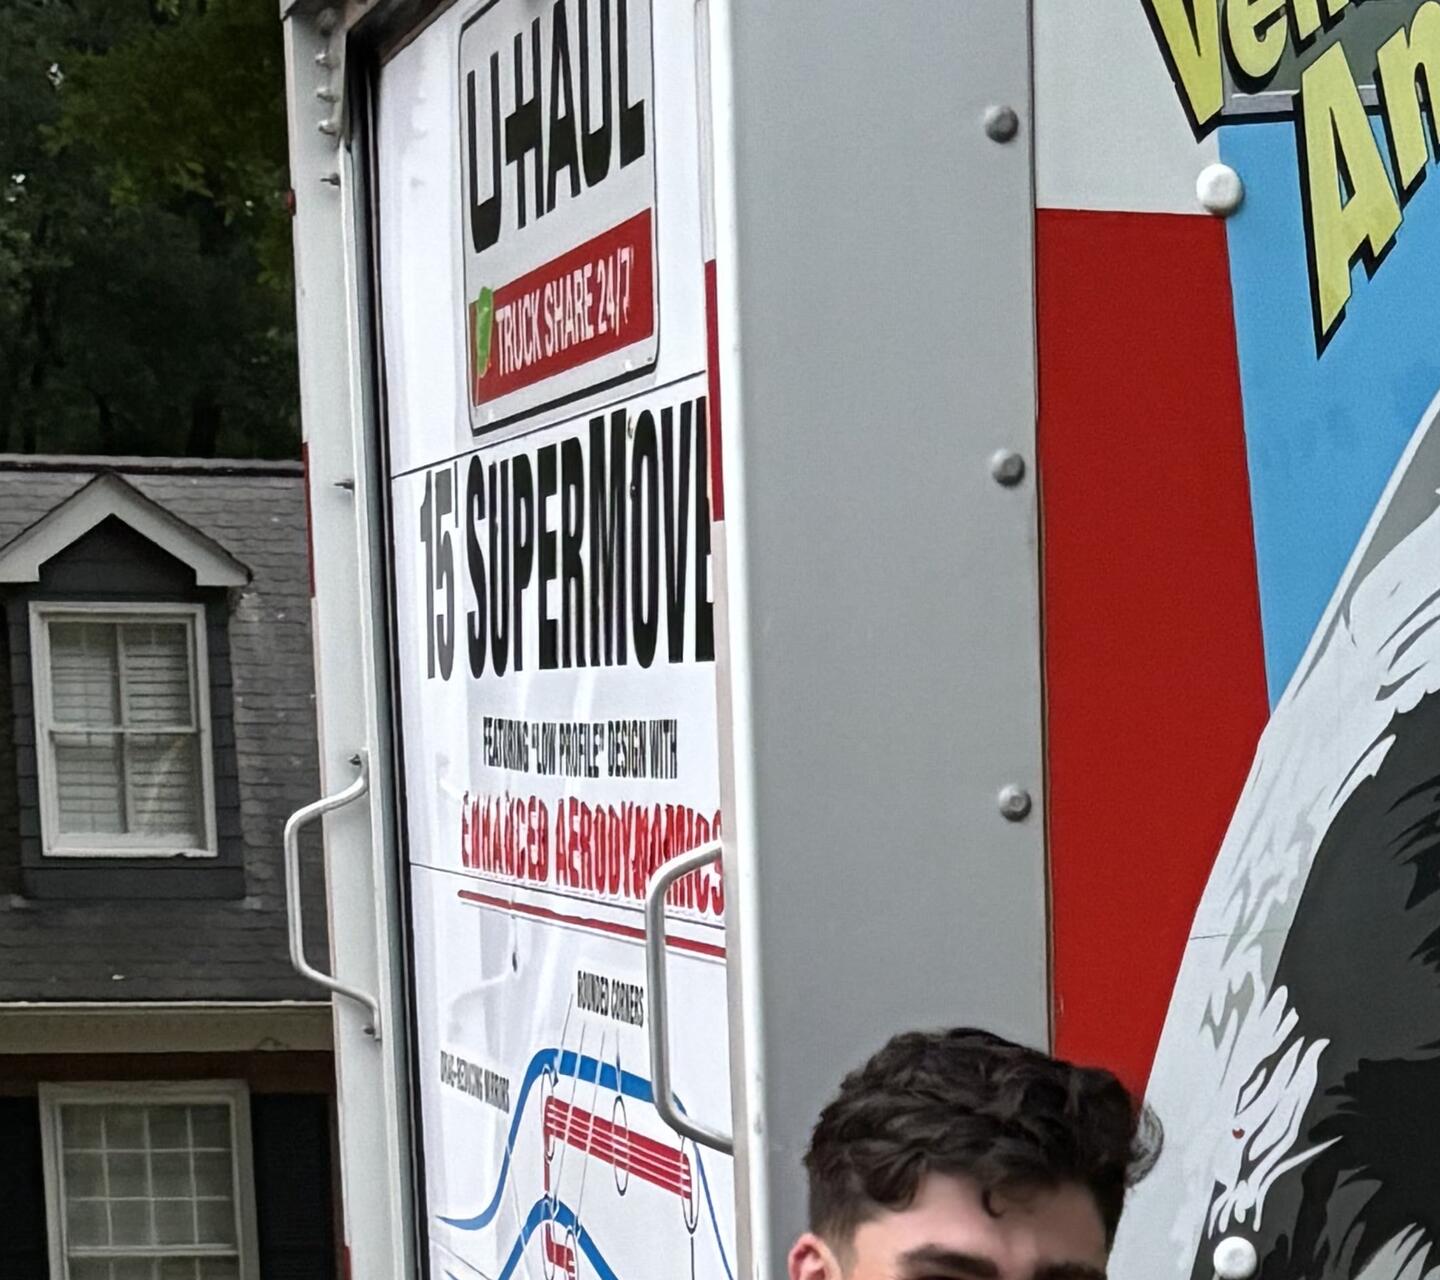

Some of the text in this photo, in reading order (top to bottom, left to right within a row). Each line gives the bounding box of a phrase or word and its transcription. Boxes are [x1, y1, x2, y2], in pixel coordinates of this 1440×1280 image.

[495, 247, 635, 377] TRUCK SHARE 24/7
[608, 719, 647, 778] DESIGN
[649, 718, 678, 780] WITH
